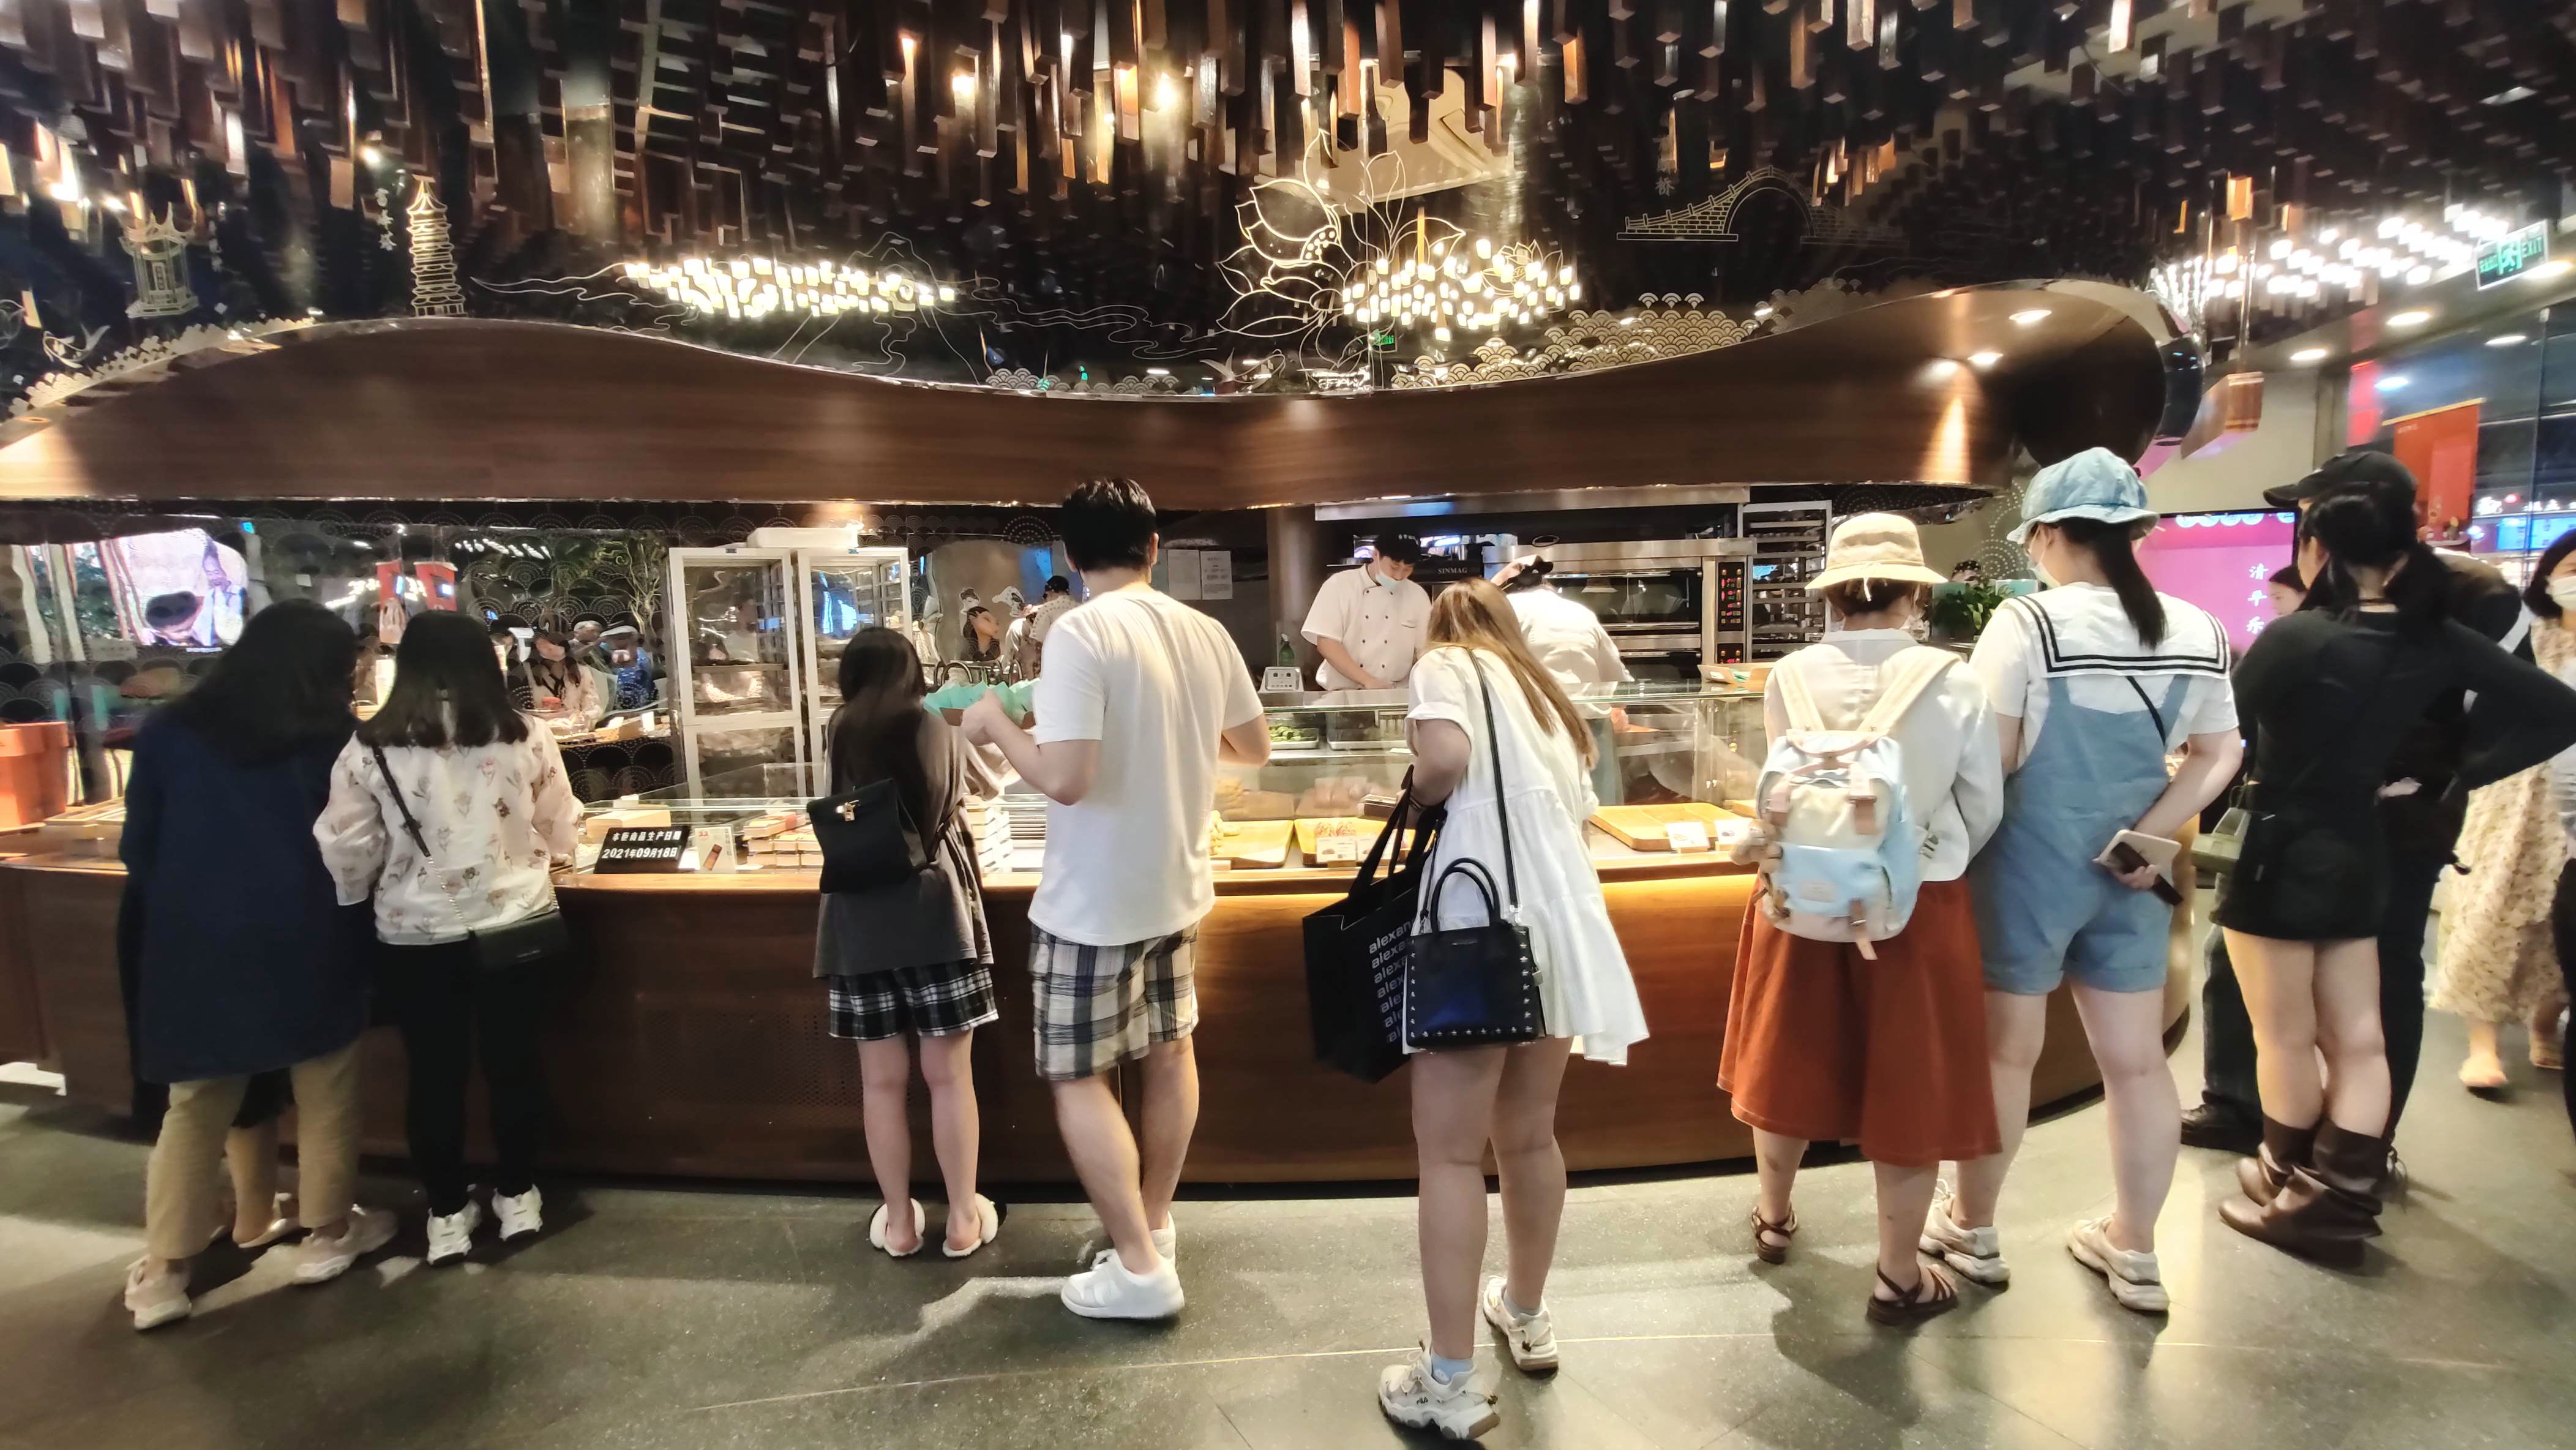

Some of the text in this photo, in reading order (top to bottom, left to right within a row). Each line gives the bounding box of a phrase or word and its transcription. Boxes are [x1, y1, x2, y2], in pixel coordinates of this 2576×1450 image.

[2522, 236, 2543, 258] EXIT
[602, 847, 677, 858] 2021年09月18日
